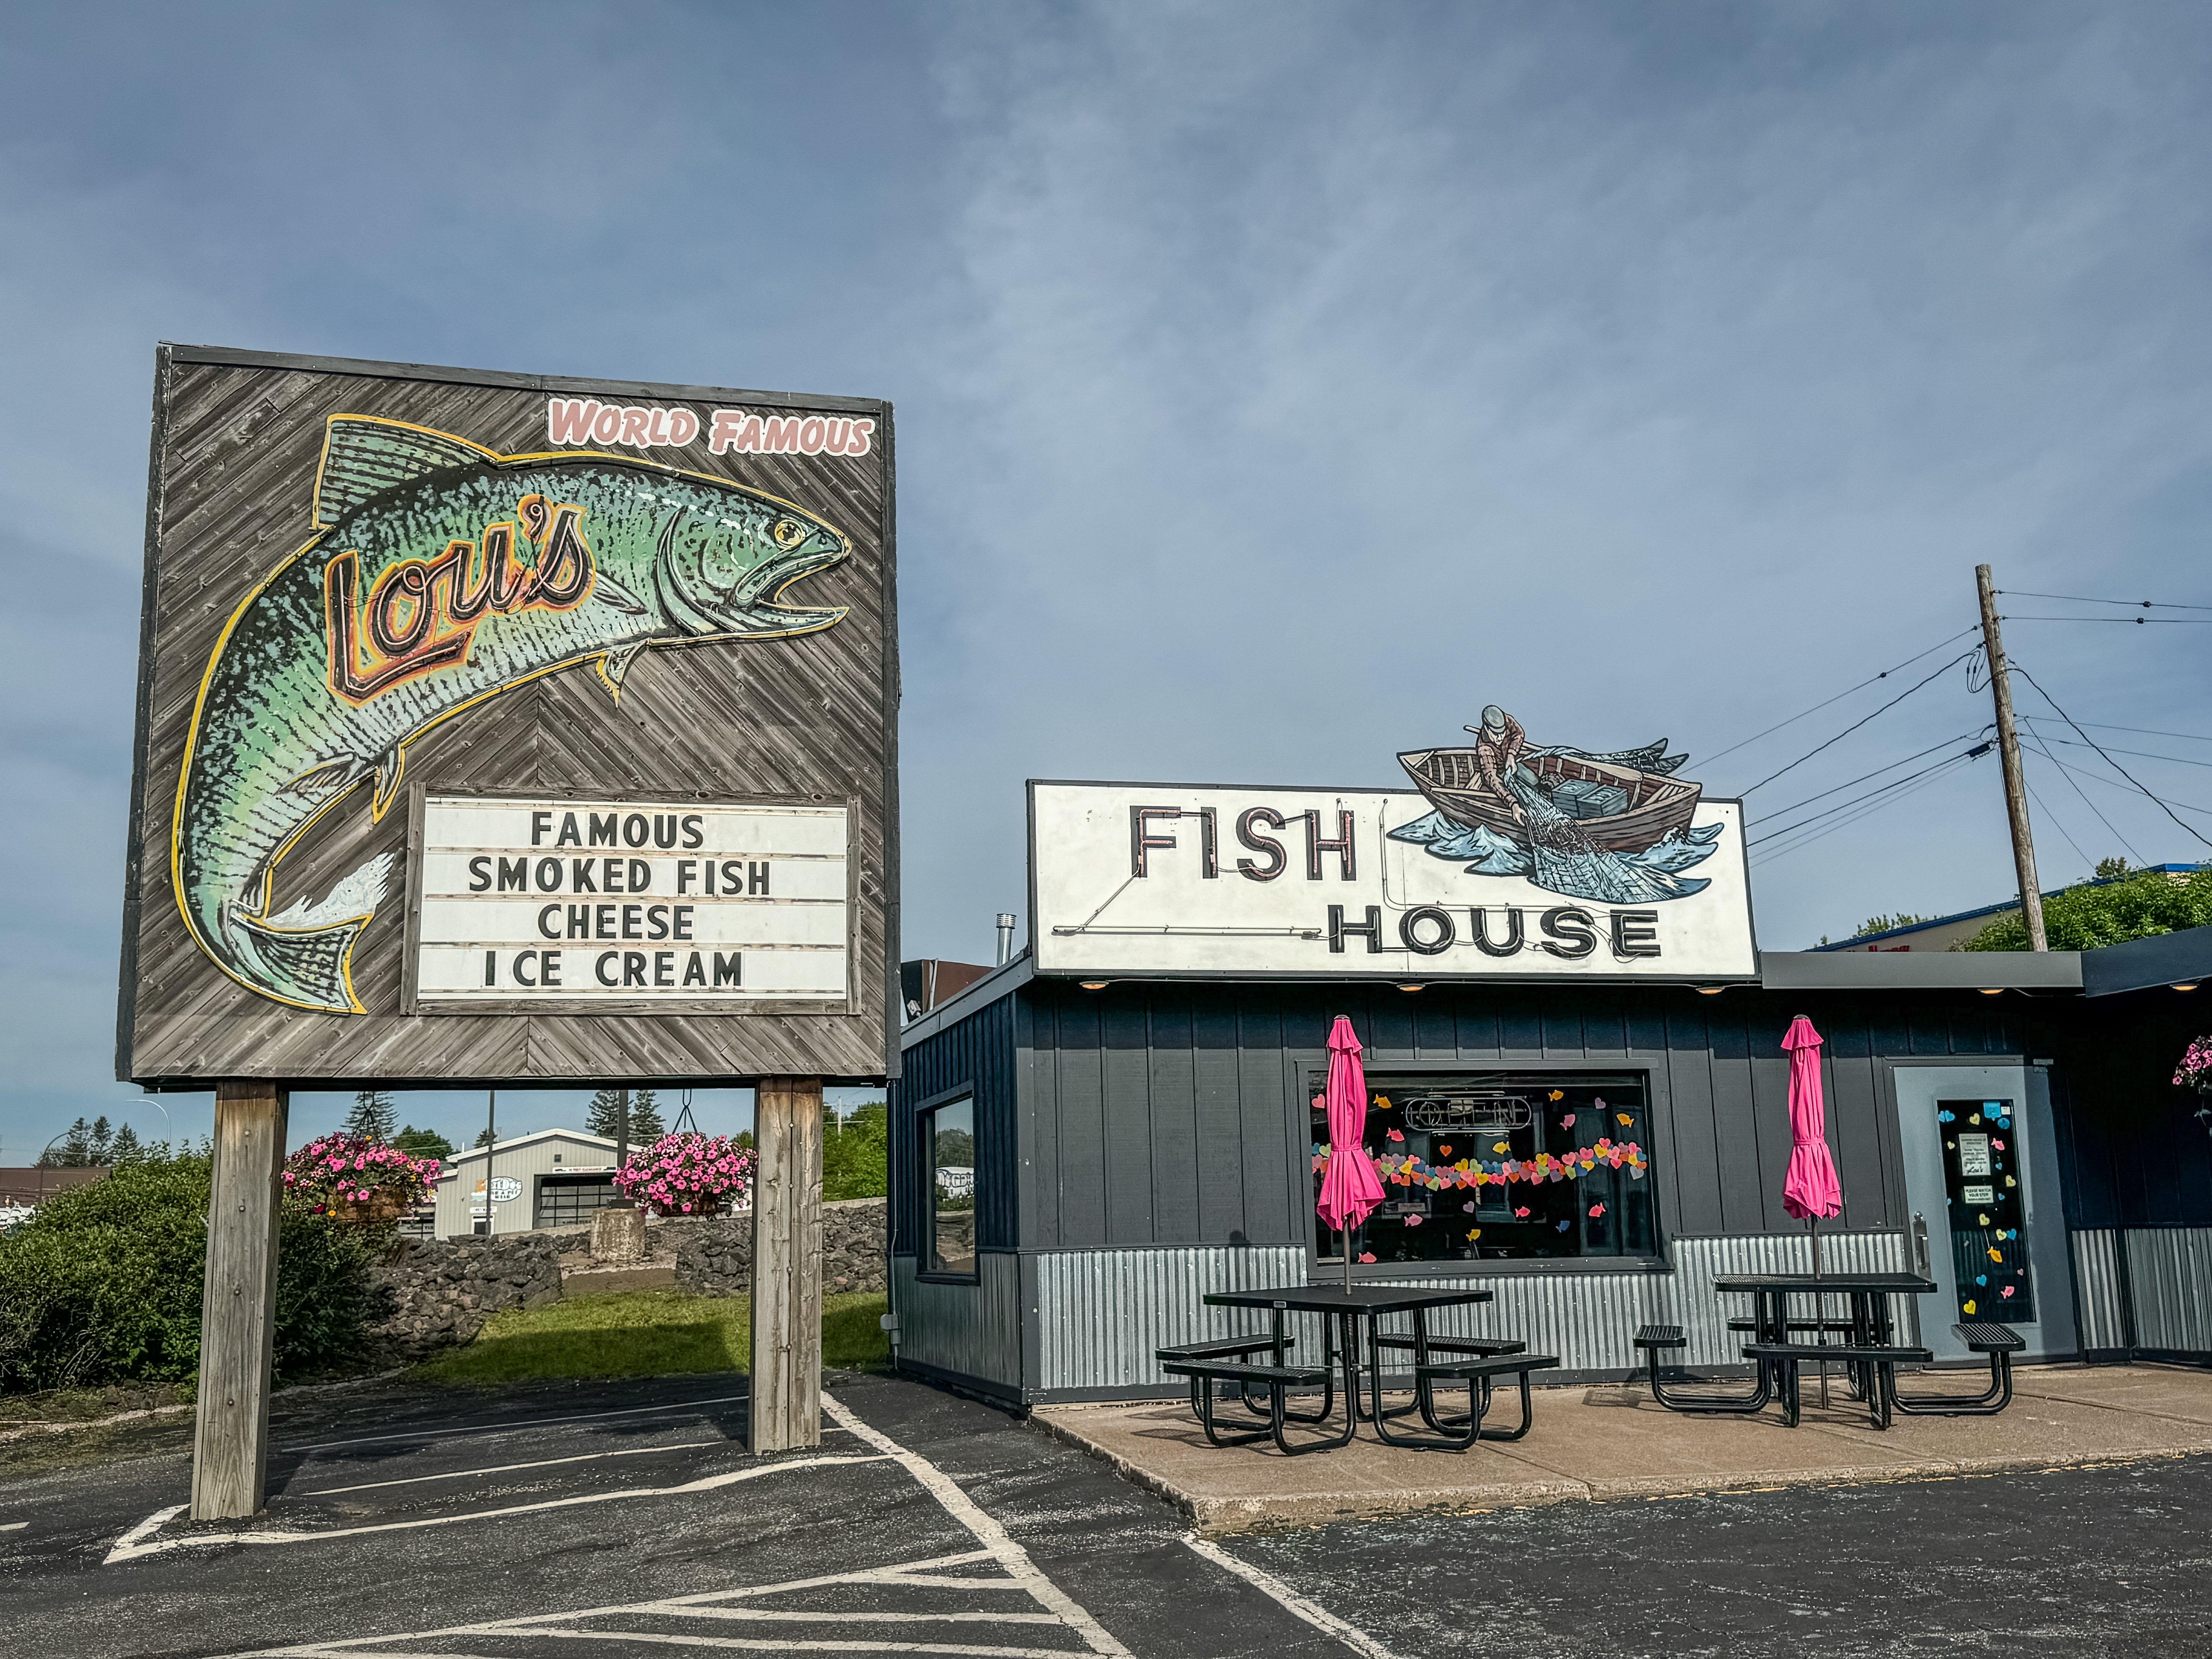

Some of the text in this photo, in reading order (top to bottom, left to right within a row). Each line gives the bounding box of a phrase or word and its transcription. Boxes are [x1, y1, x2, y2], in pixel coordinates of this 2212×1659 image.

[325, 495, 594, 706] Lou's
[532, 812, 703, 848] FAMOUS
[1130, 805, 1357, 883] FISH
[469, 857, 770, 896] SMOKED FISH
[538, 904, 694, 939] CHEESE
[1328, 905, 1662, 959] HOUSE
[485, 950, 742, 986] ICE CREAM
